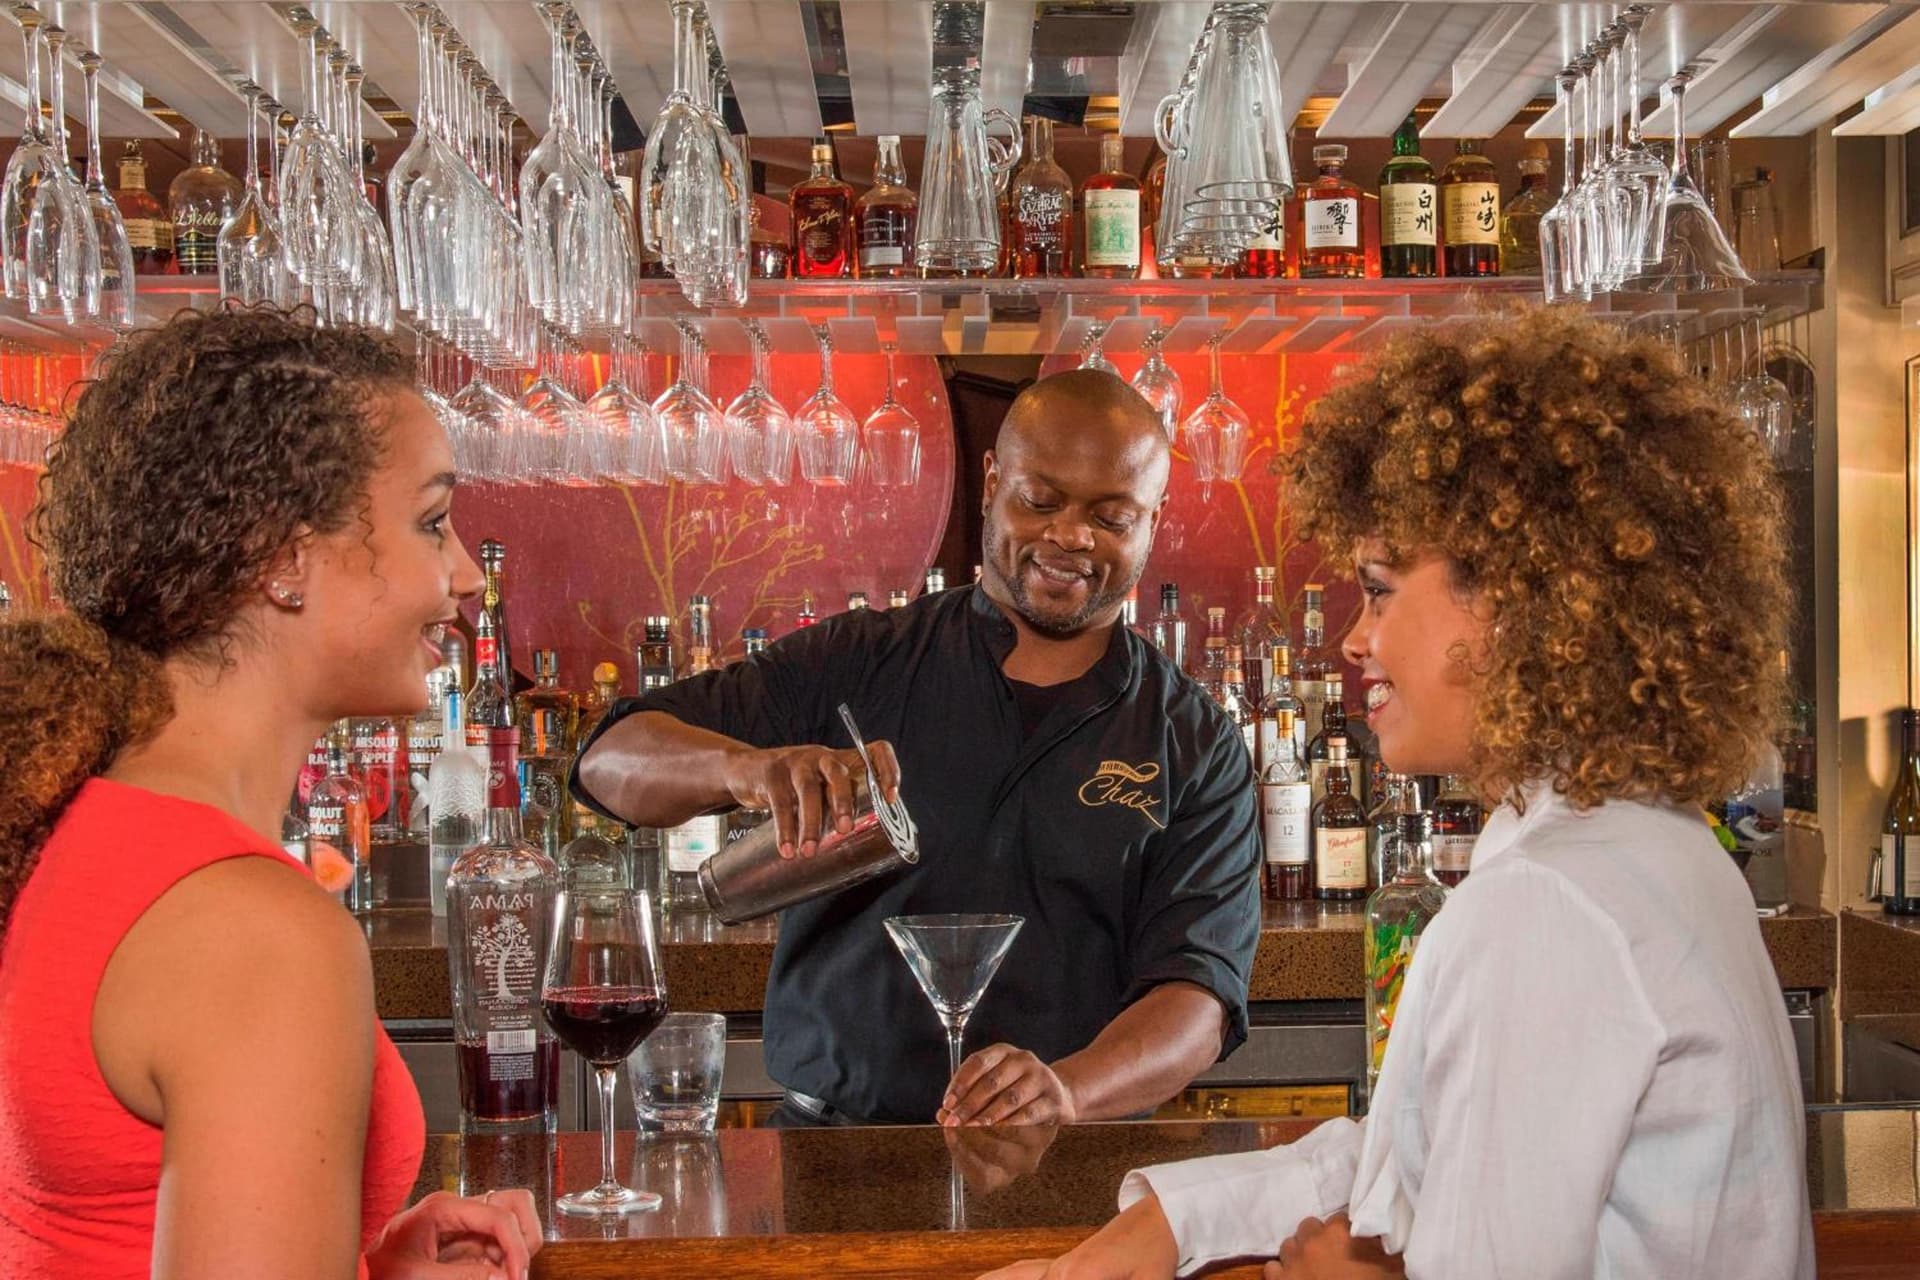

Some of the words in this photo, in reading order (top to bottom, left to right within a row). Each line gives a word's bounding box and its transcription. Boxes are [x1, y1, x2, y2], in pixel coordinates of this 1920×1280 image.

[1416, 189, 1433, 235] 白州
[1477, 190, 1496, 232] 山崎
[355, 736, 399, 749] ABSOLUT
[409, 736, 444, 748] SOLUT
[1283, 824, 1294, 836] 12
